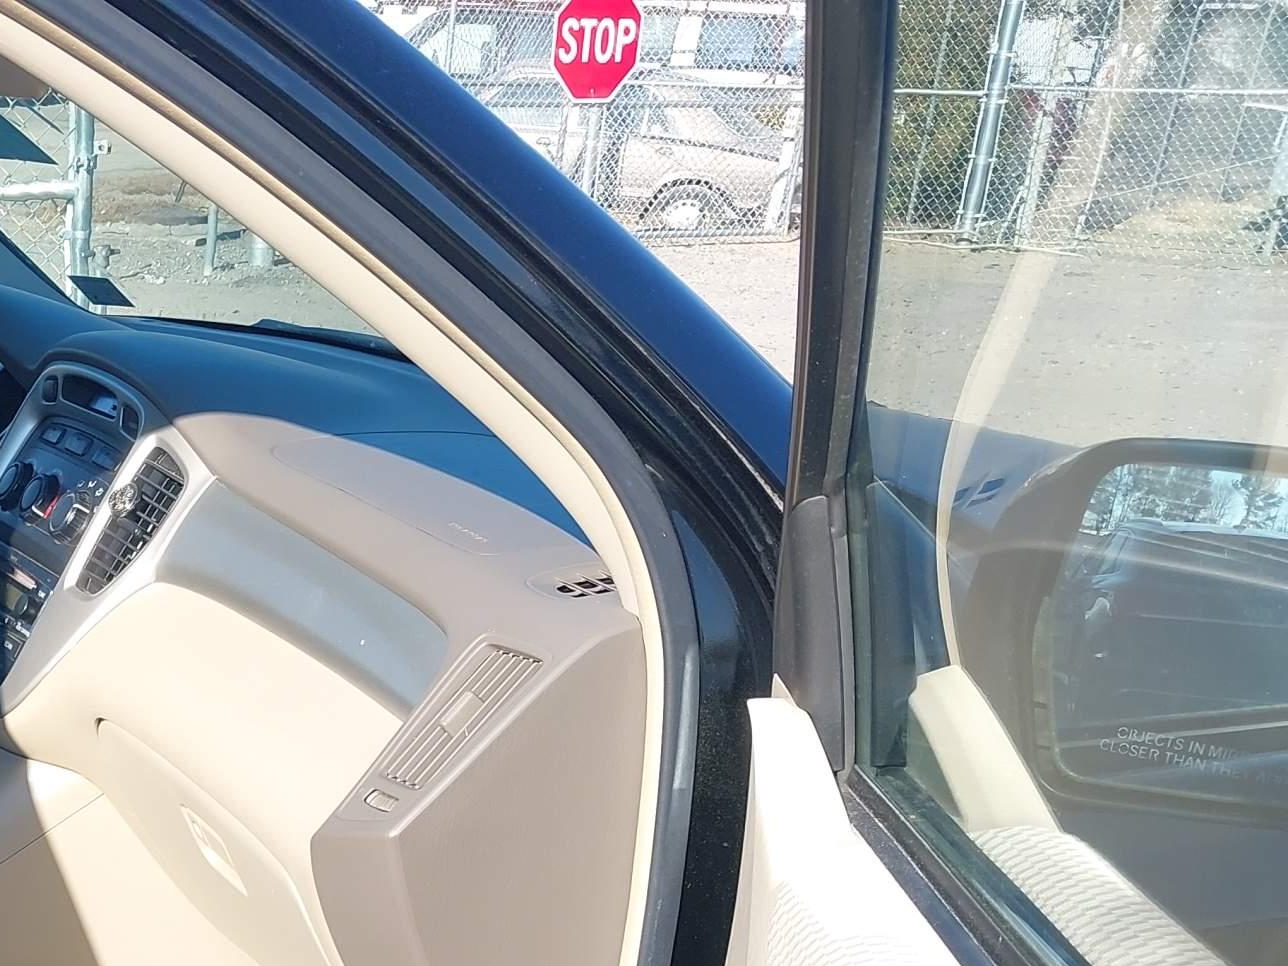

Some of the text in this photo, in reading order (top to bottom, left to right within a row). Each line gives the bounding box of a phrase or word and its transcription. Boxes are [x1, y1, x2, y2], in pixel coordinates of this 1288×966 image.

[558, 16, 637, 64] STOP
[1099, 738, 1159, 760] CLOSER
[1165, 751, 1206, 771] THAN
[1117, 727, 1184, 750] OBJECTS
[1188, 740, 1206, 755] IN
